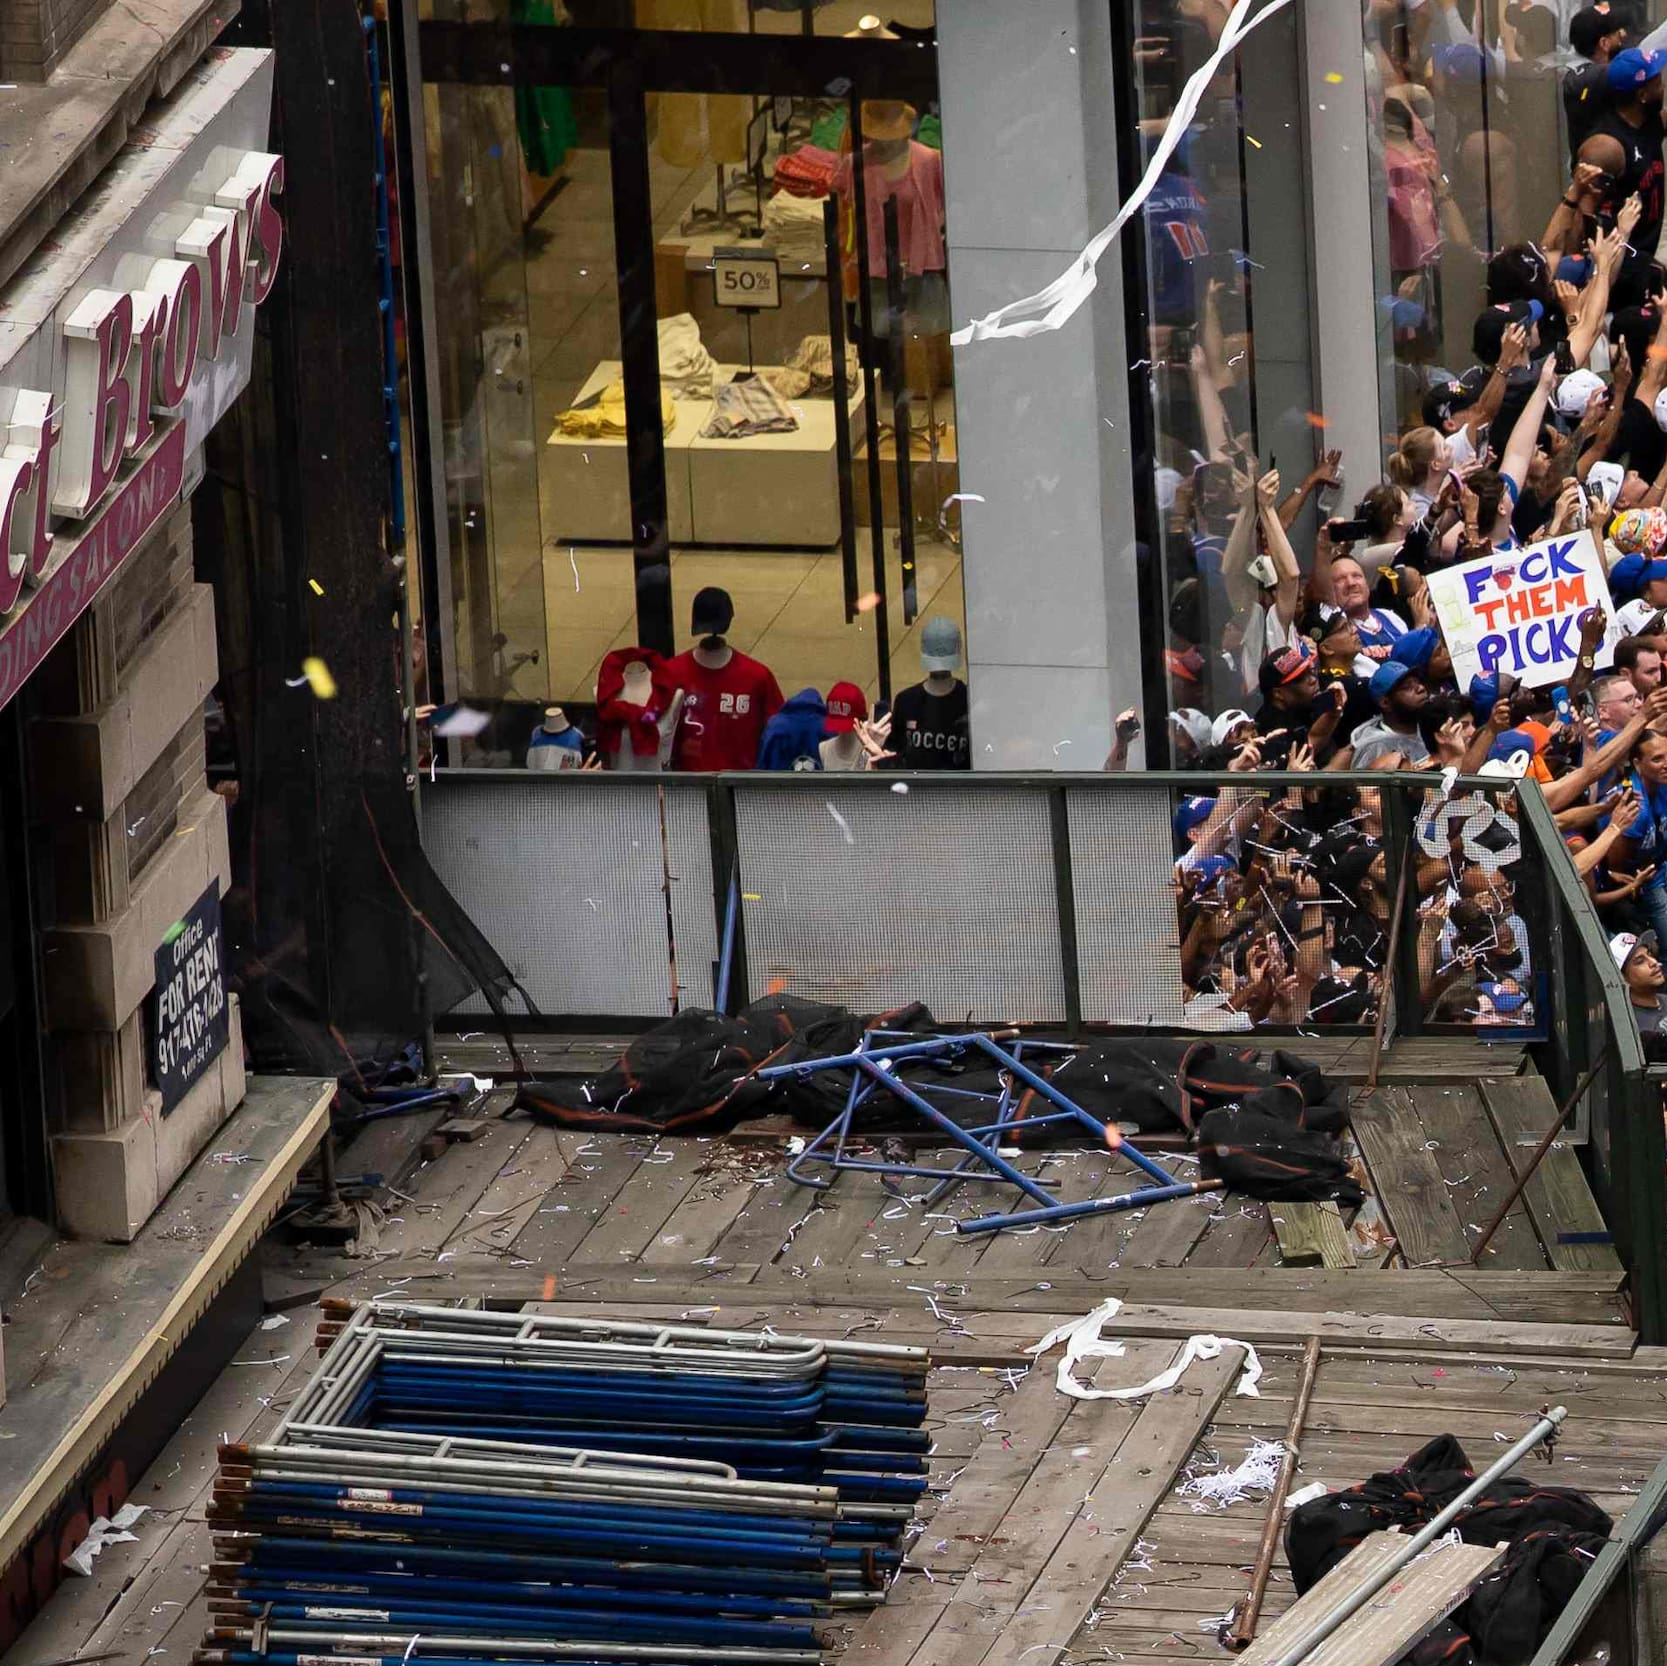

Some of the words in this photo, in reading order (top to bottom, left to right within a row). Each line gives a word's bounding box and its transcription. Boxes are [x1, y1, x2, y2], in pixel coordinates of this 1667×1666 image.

[1473, 572, 1586, 629] THEM
[719, 692, 751, 714] 26
[173, 918, 205, 967] Office
[158, 971, 185, 1034] FOR
[186, 928, 221, 1001] RENT
